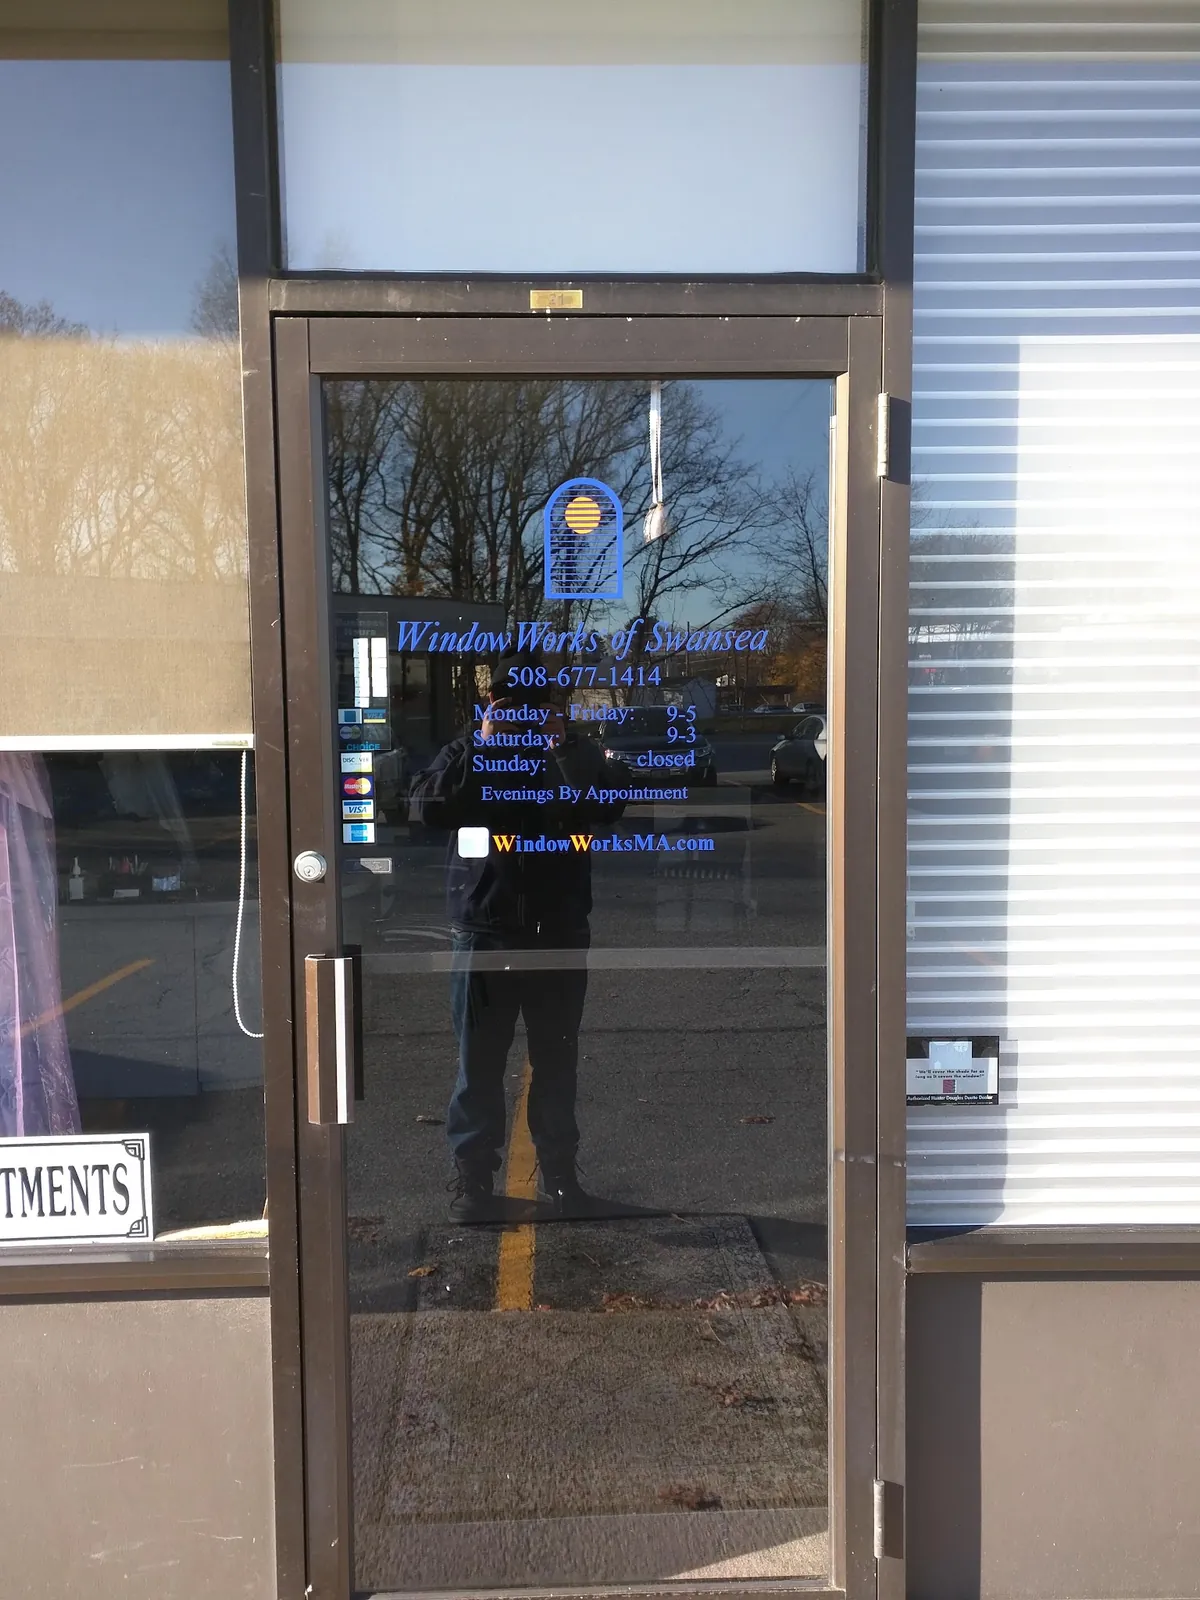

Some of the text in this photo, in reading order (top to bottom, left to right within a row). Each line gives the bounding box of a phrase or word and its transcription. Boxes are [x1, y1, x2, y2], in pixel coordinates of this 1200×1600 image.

[611, 618, 645, 661] of
[644, 620, 769, 653] Swansea
[507, 665, 662, 688] 508-677-1414
[473, 703, 550, 725] Monday
[570, 703, 634, 725] Friday:
[666, 704, 697, 724] 9-5
[473, 725, 697, 751] Saturday: 9-3
[472, 749, 696, 776] Sunday: closed
[481, 784, 688, 804] Evenings By Appointment
[493, 833, 715, 853] WindowWorksMA.com
